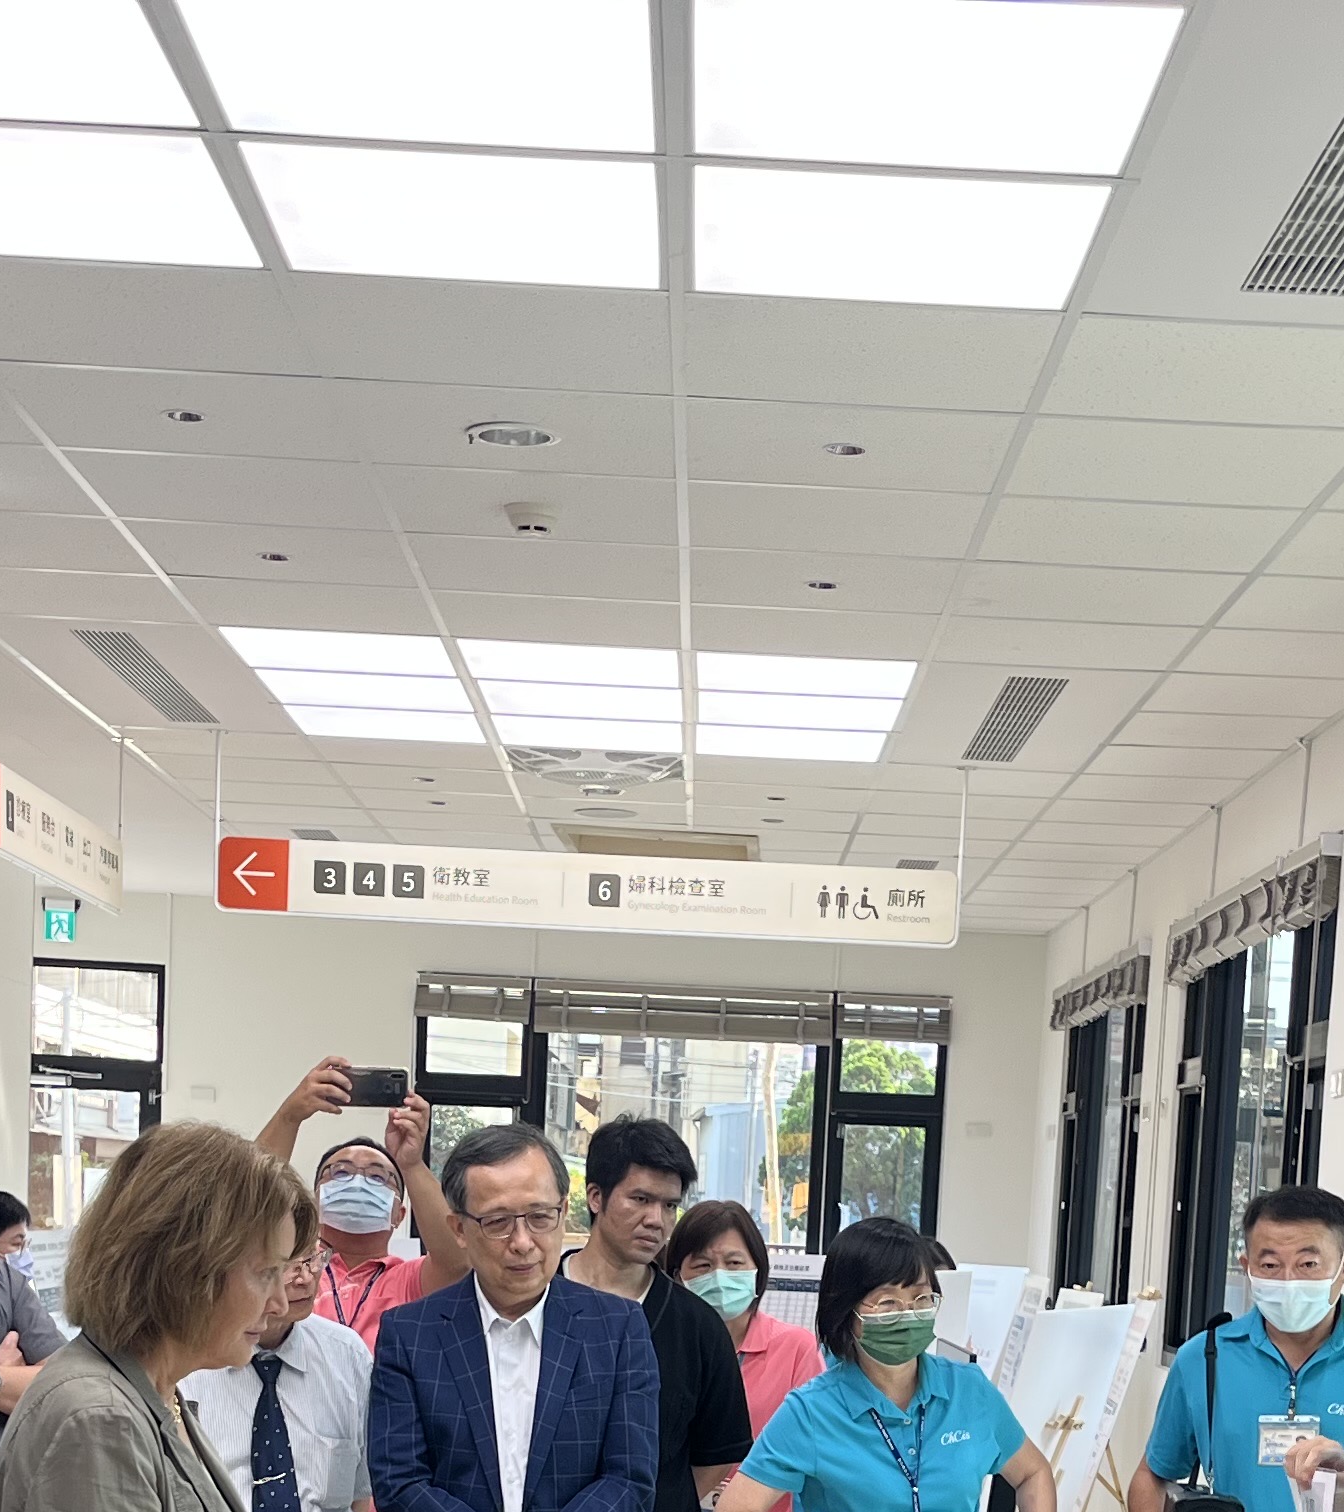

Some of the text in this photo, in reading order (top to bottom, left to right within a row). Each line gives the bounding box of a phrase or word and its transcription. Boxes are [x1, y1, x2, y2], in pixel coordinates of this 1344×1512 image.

[322, 867, 416, 892] 3 4 5
[432, 866, 491, 888] 衛教室
[627, 874, 726, 898] 婦科檢查室
[432, 891, 539, 906] Health Education Room
[597, 879, 612, 901] 6
[886, 888, 926, 909] 廁所
[627, 899, 767, 916] Gynecology Examination Room
[886, 913, 931, 925] Restroom
